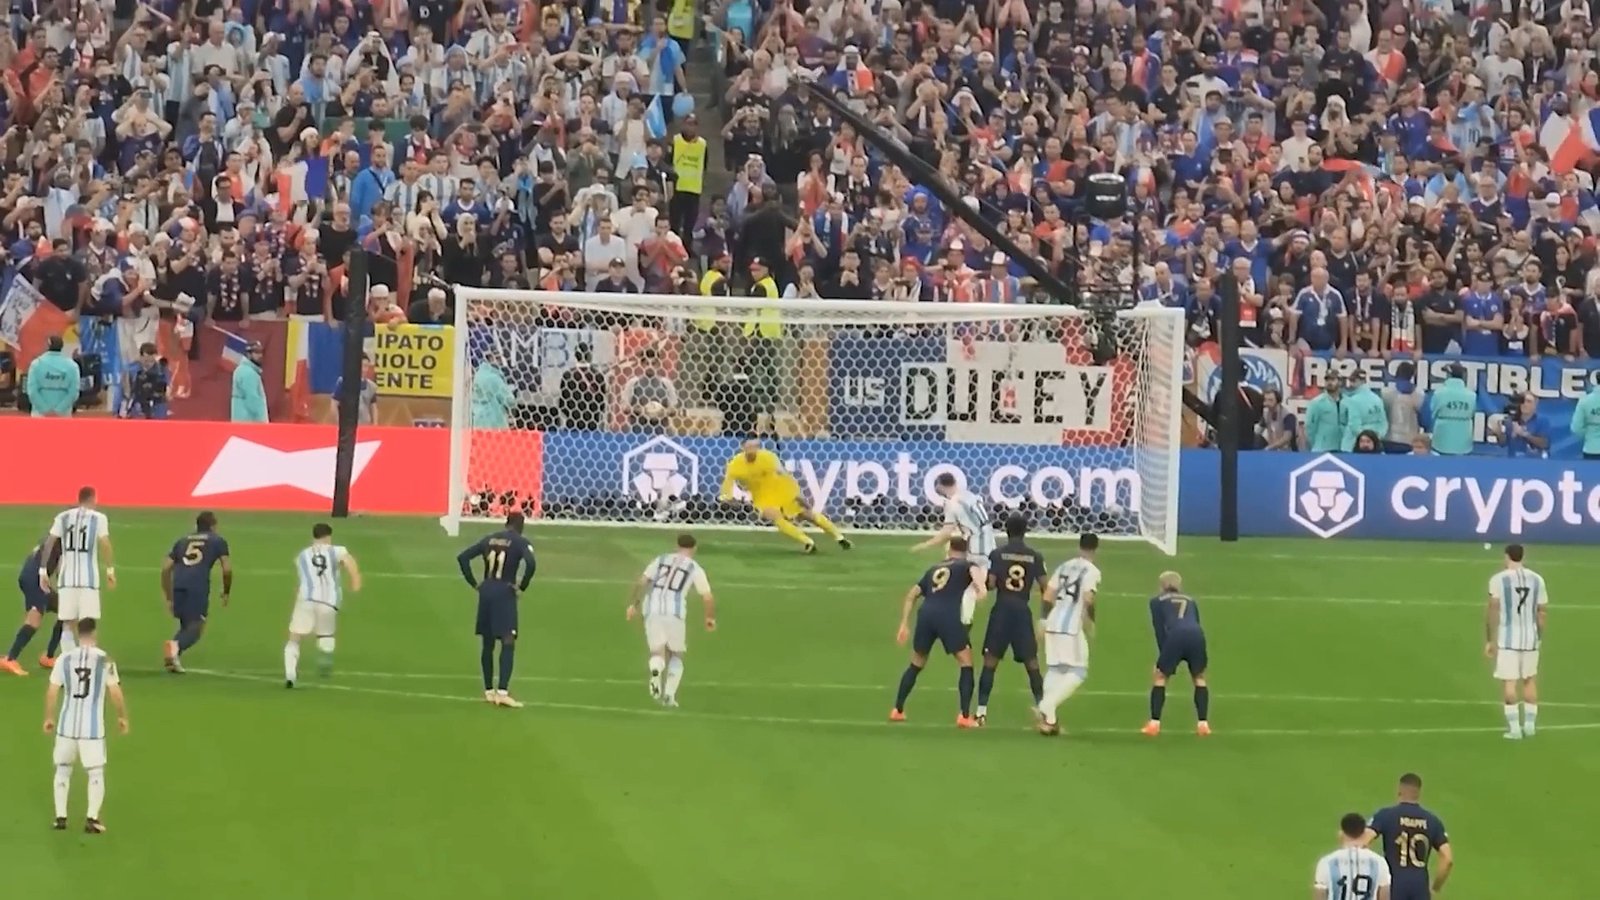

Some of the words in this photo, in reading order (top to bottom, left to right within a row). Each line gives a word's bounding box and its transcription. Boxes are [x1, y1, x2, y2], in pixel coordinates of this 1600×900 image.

[377, 333, 444, 351] IPATO
[904, 366, 1107, 426] DUCEY
[65, 523, 89, 553] 11
[182, 541, 205, 566] 5
[311, 553, 328, 577] 9
[487, 549, 506, 579] 11
[653, 563, 689, 591] 20
[931, 566, 951, 593] 9
[1005, 564, 1026, 592] 8
[1171, 599, 1188, 619] 7
[1515, 586, 1531, 615] 7
[73, 667, 92, 699] 3
[1395, 831, 1430, 868] 10
[1337, 874, 1373, 900] 19
